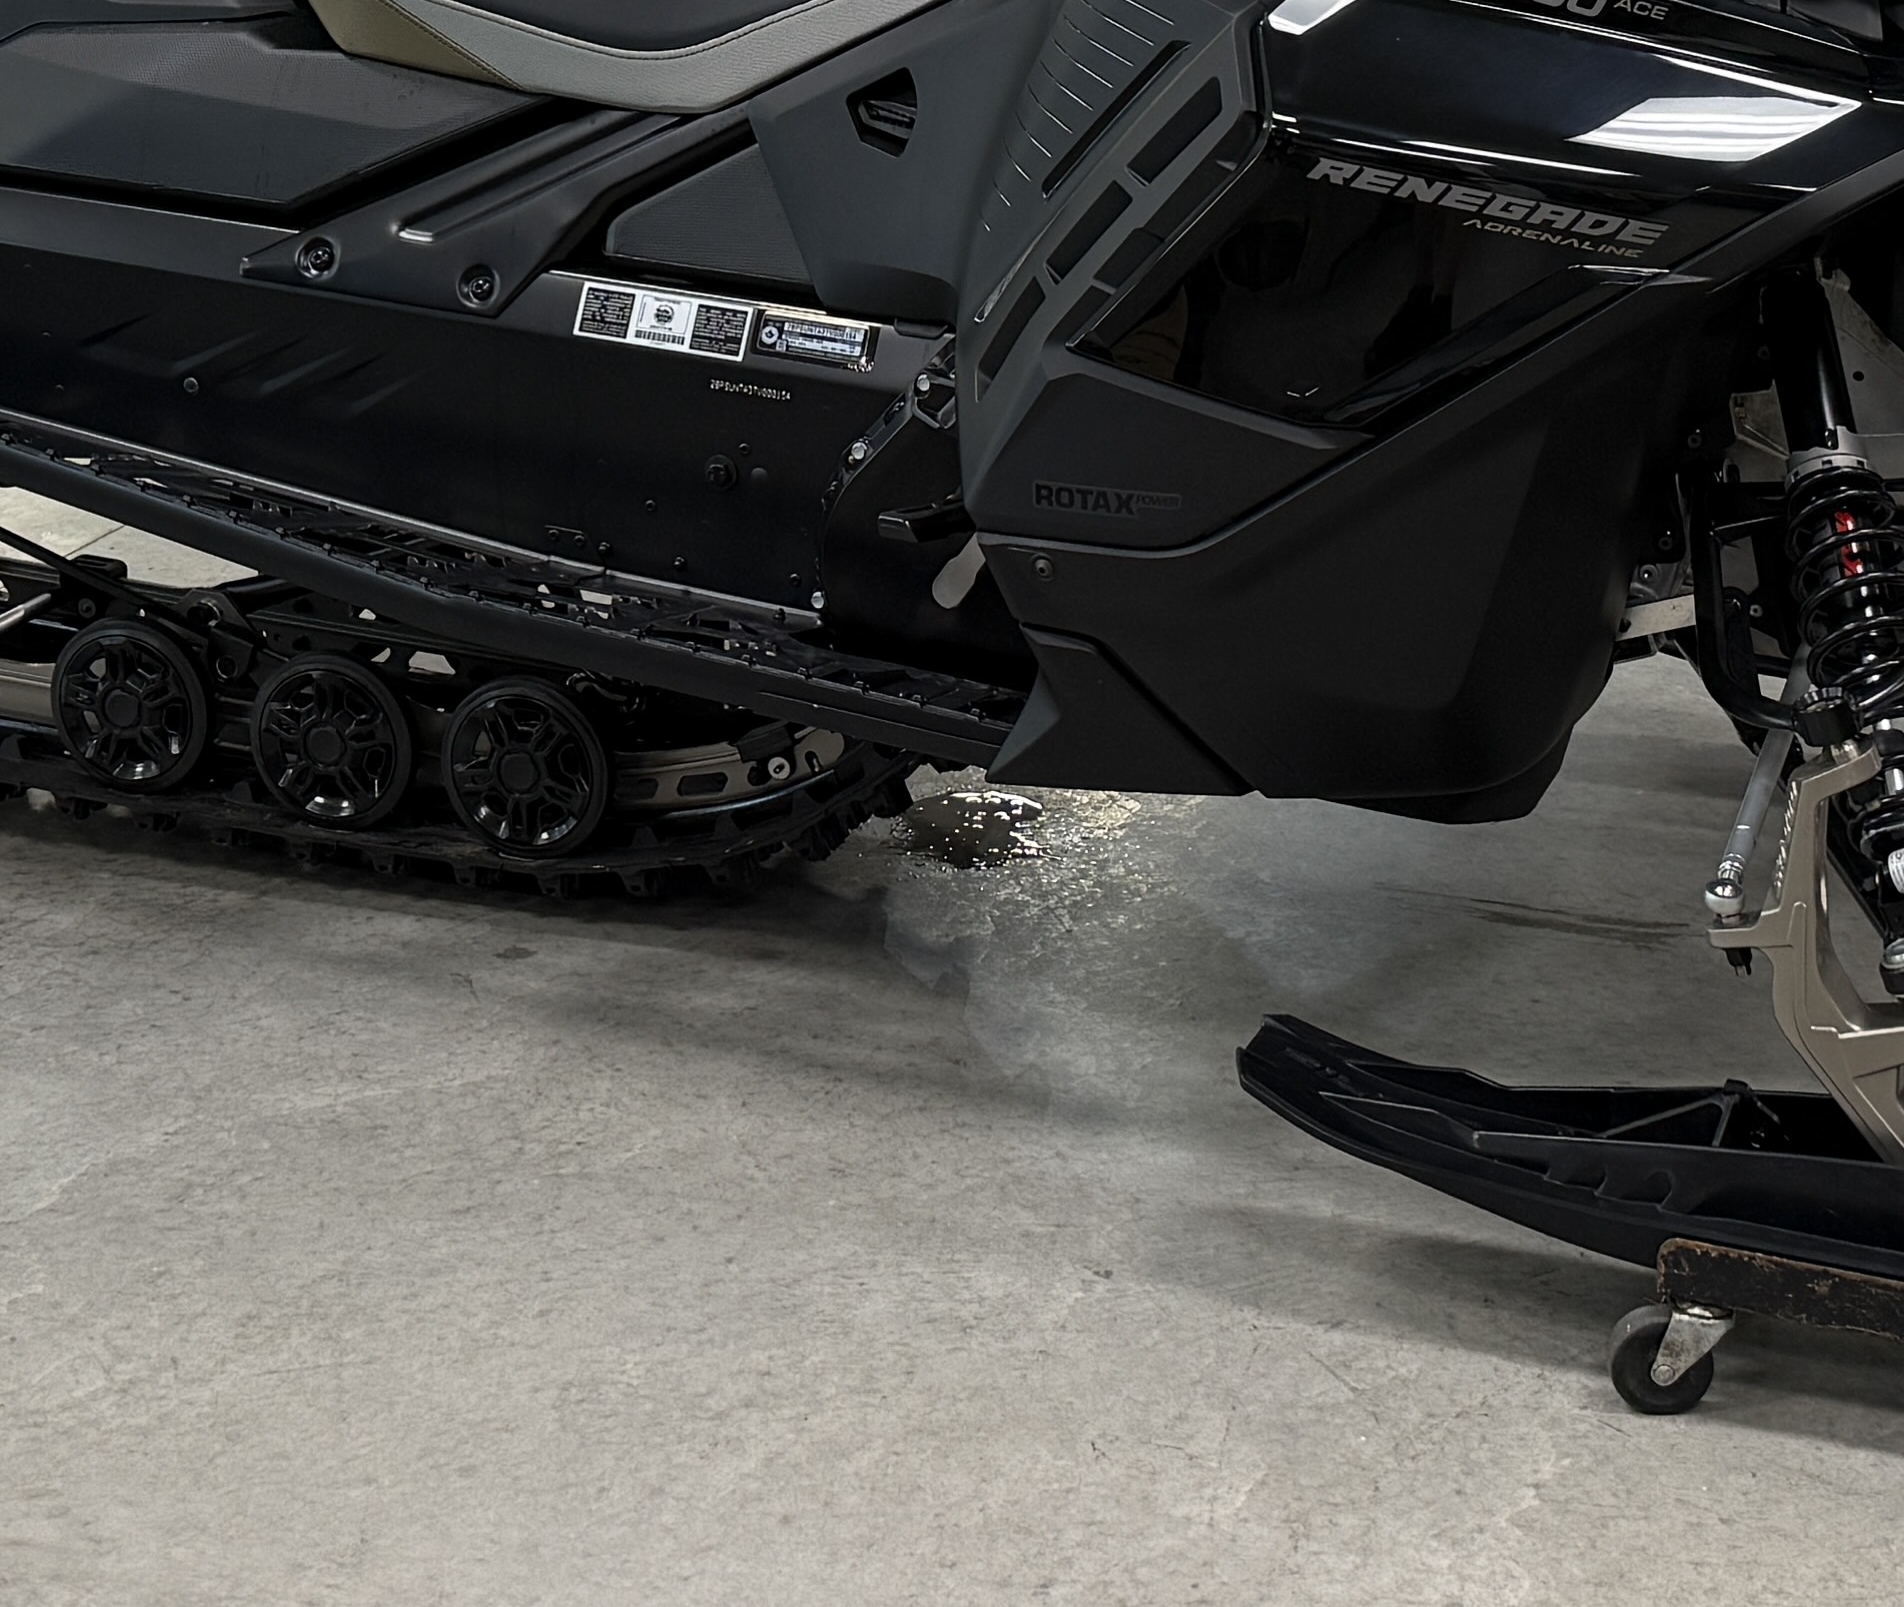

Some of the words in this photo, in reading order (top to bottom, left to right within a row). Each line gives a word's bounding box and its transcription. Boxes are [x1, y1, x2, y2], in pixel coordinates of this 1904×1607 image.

[1306, 156, 1670, 245] RENEGADE
[1462, 216, 1644, 258] ADRENALINE
[1033, 482, 1136, 517] ROTAX
